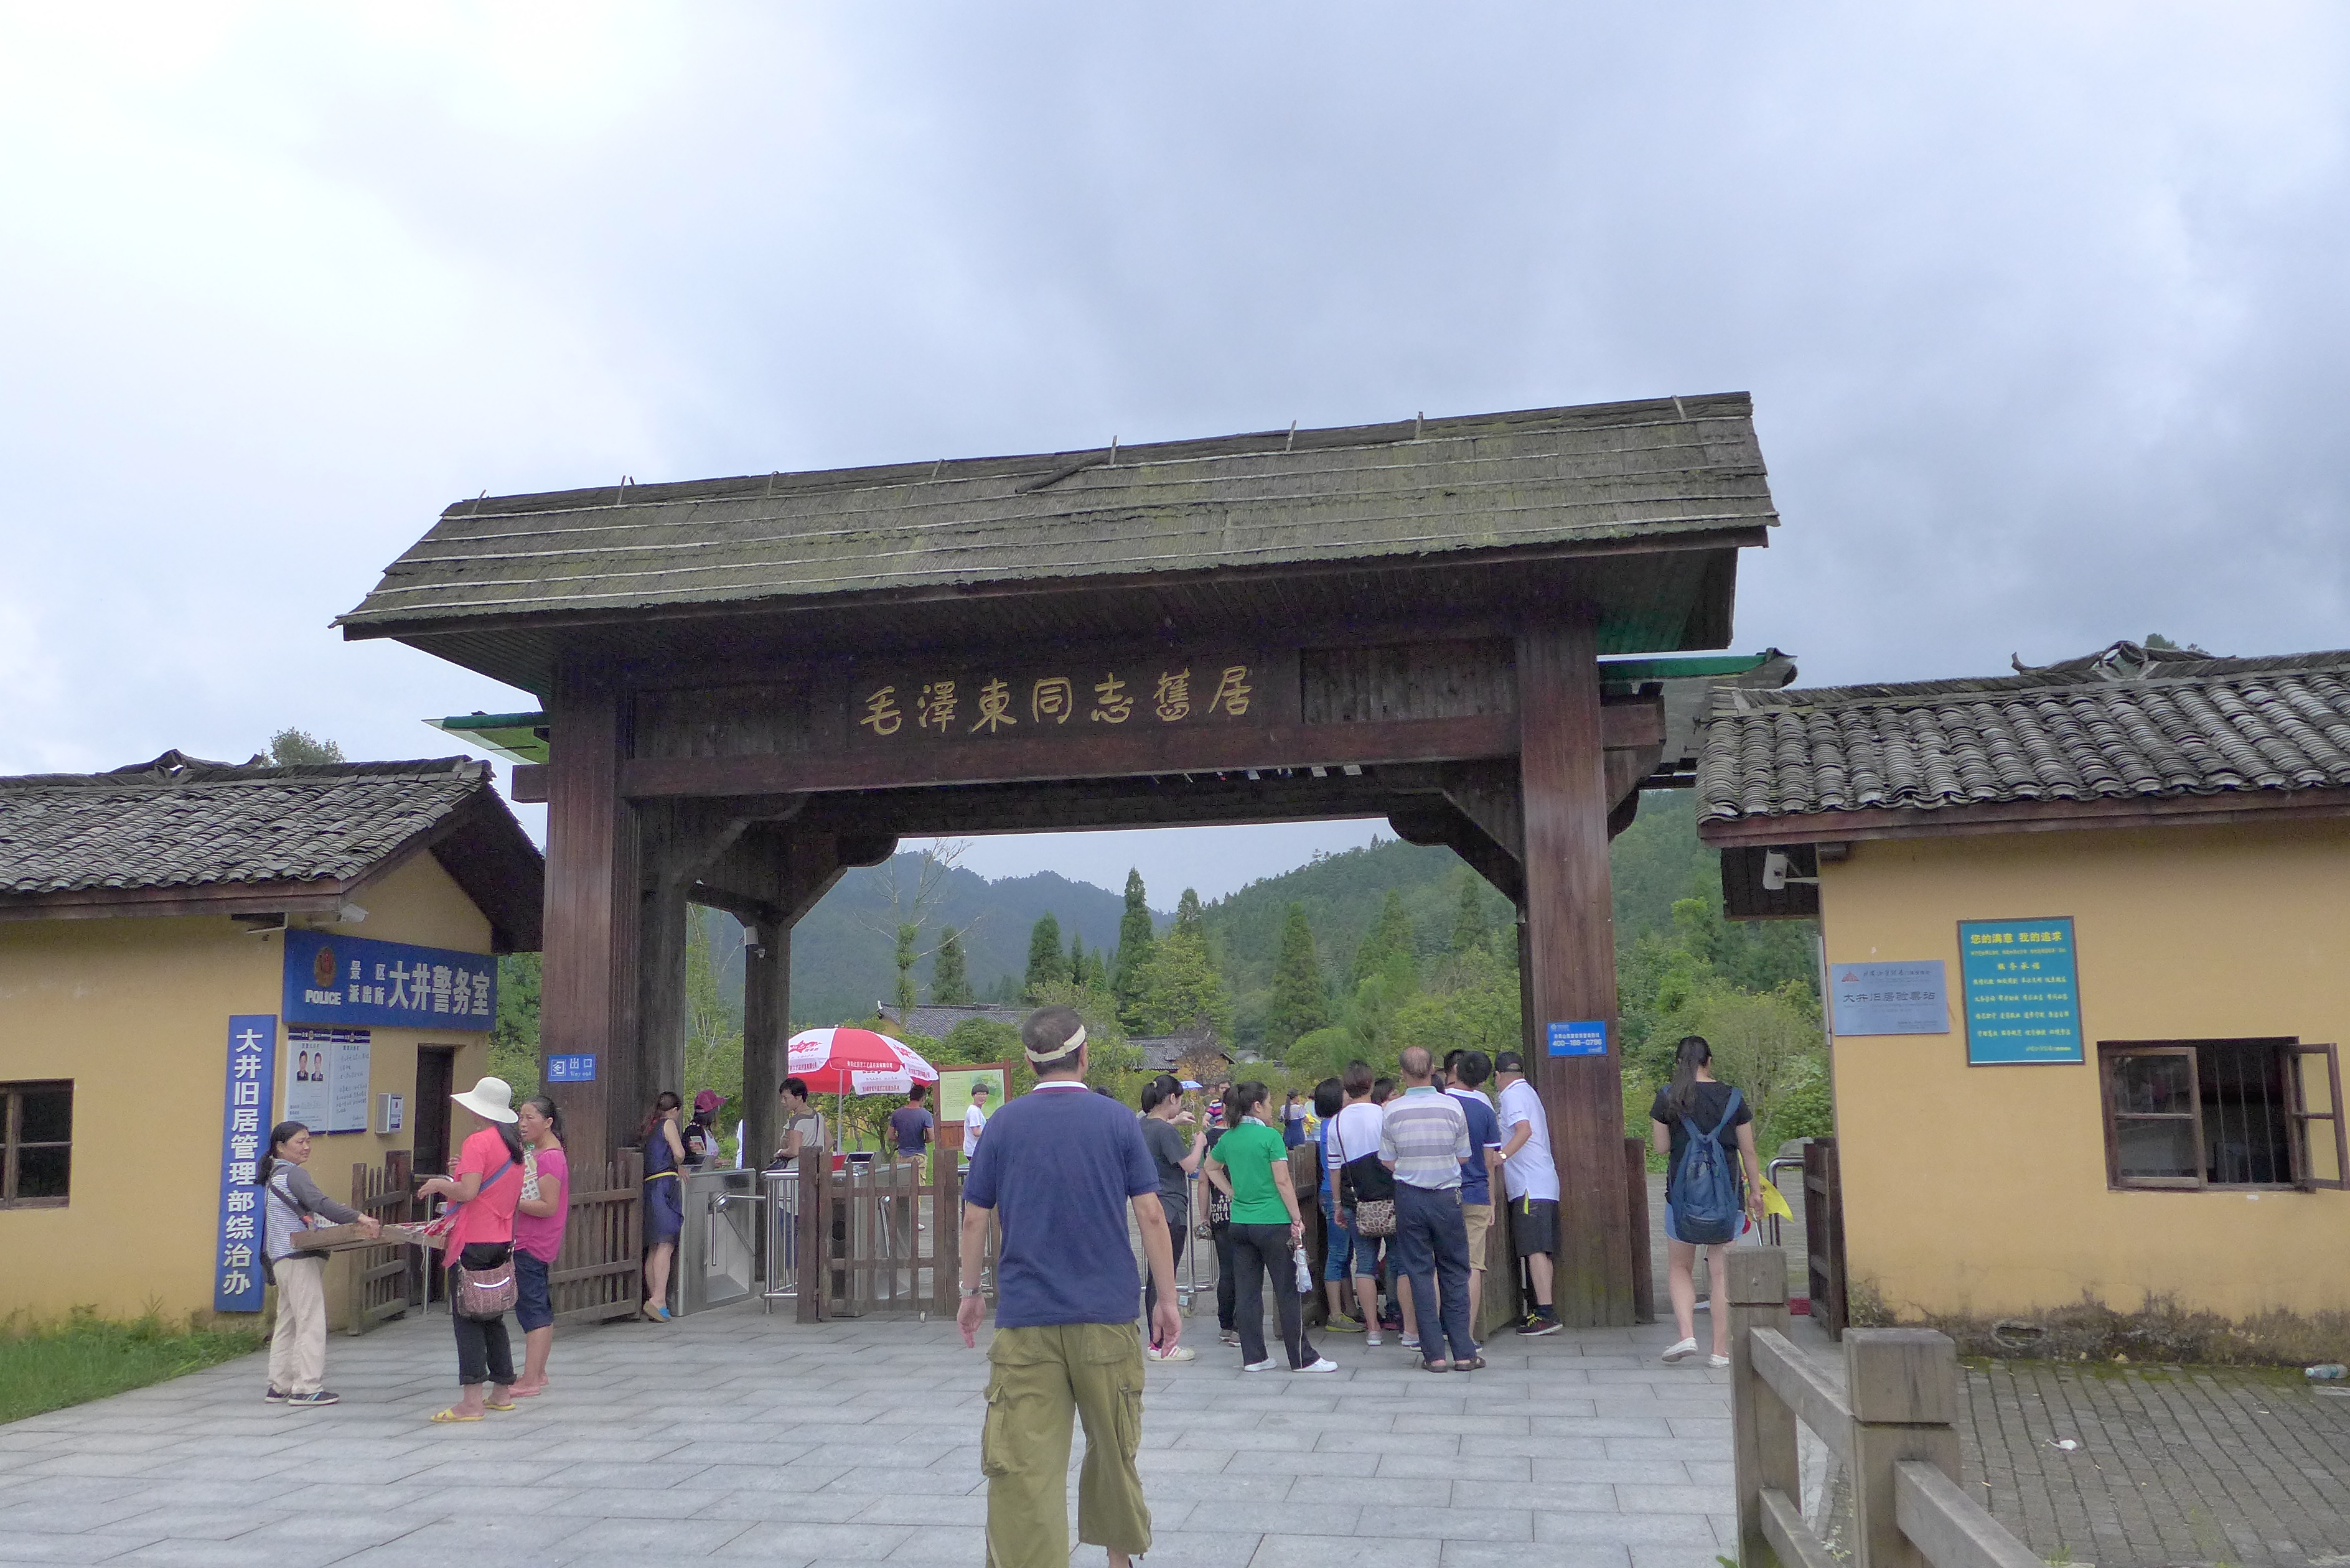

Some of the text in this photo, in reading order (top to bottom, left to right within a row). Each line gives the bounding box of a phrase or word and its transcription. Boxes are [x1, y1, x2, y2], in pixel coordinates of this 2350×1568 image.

[305, 989, 342, 1006] POLICE
[348, 984, 385, 1006] 派出所
[387, 960, 490, 1015] 大井警务室
[569, 1057, 592, 1070] 出口
[223, 1029, 263, 1295] 大井旧居管理部综治办
